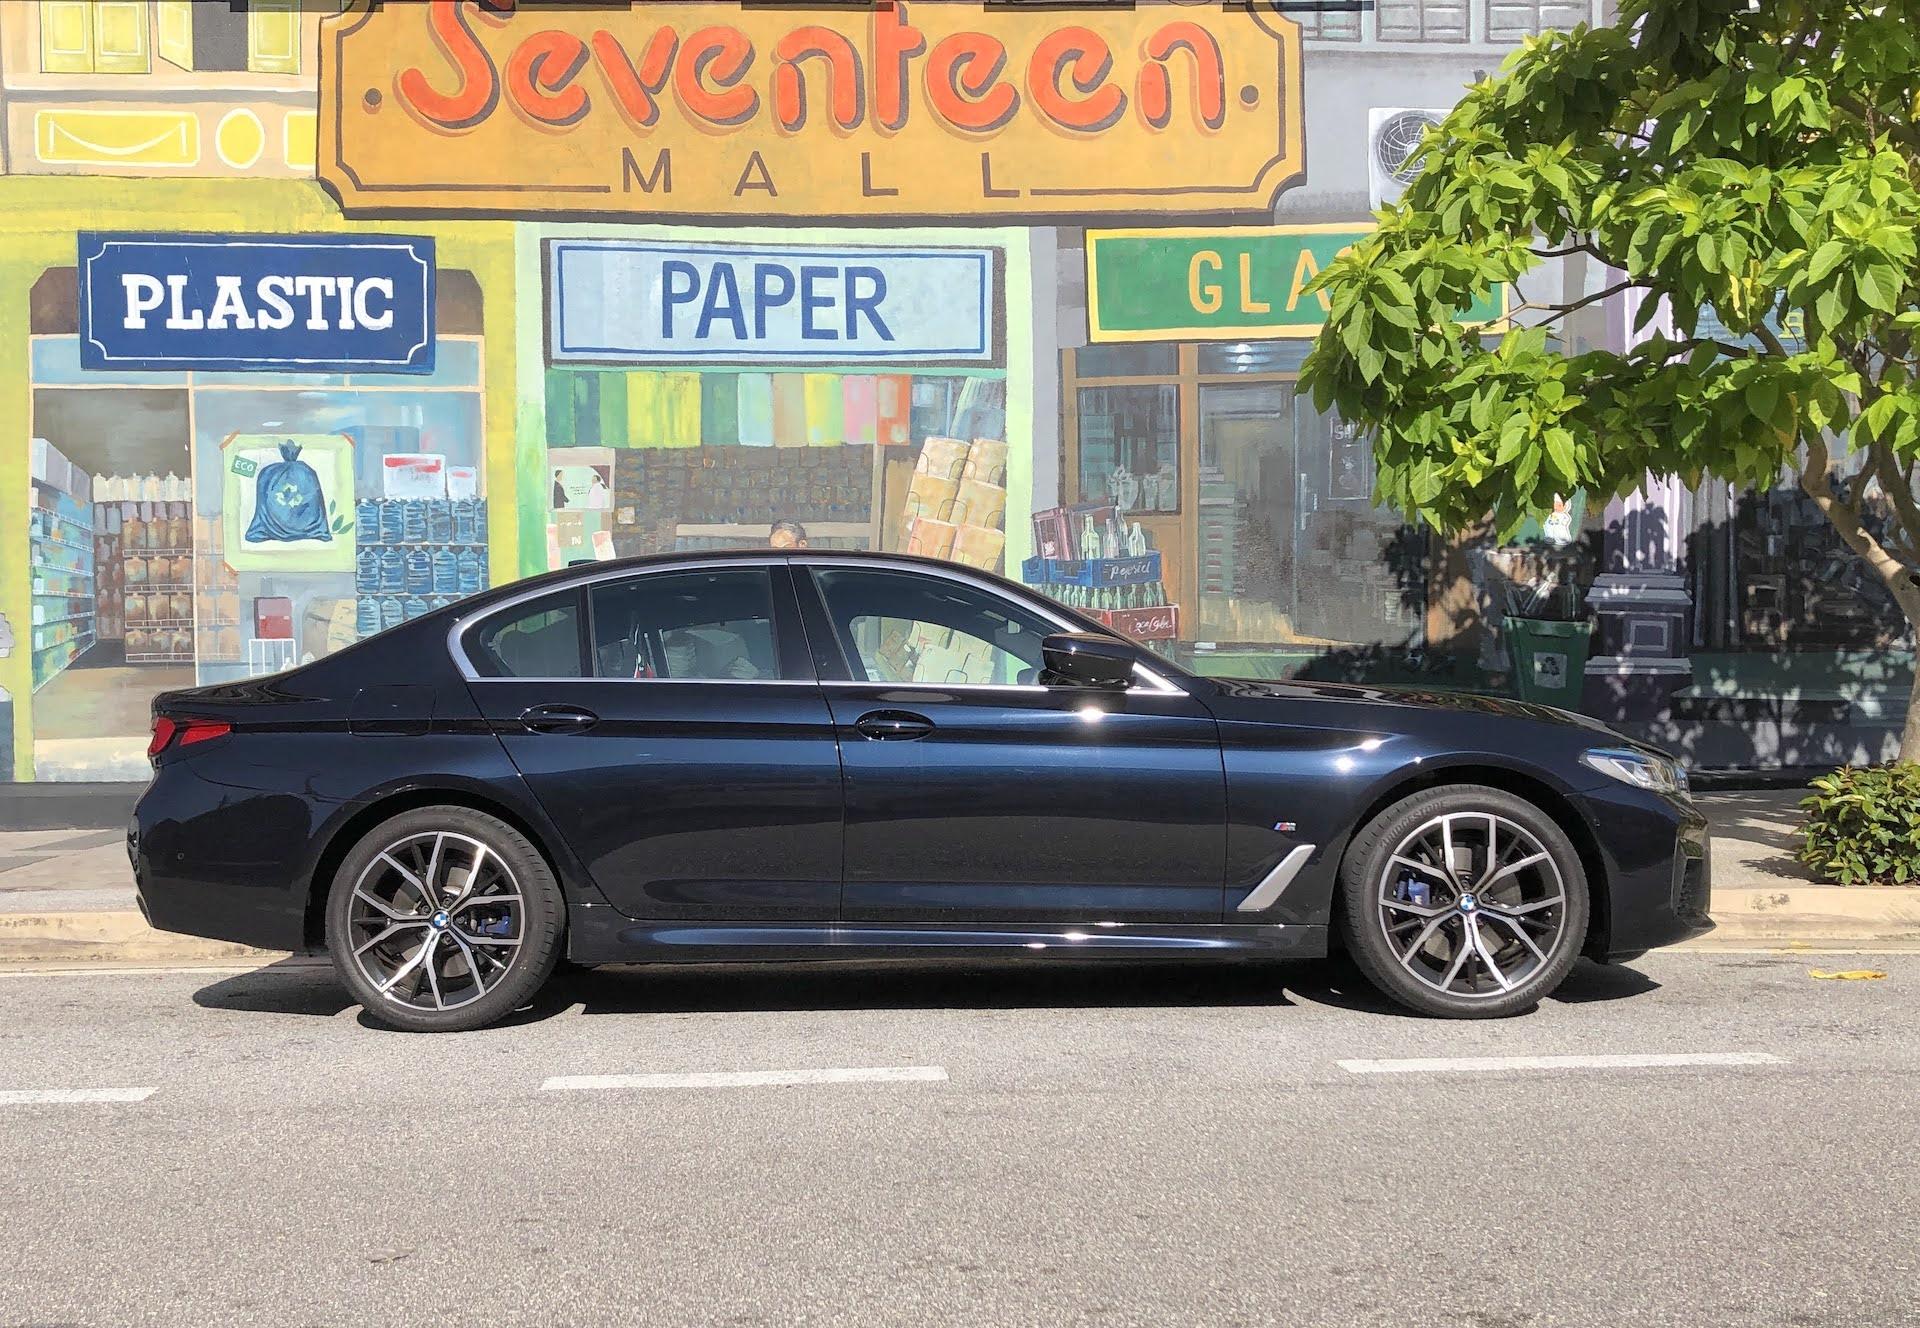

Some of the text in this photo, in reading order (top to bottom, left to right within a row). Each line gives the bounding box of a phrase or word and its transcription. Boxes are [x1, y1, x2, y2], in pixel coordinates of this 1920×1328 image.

[397, 0, 1226, 131] Seventeen
[621, 147, 1021, 198] MALL
[121, 273, 395, 331] PLASTIC
[661, 260, 896, 343] PAPER
[1188, 246, 1352, 313] GLA
[234, 460, 254, 472] ECO
